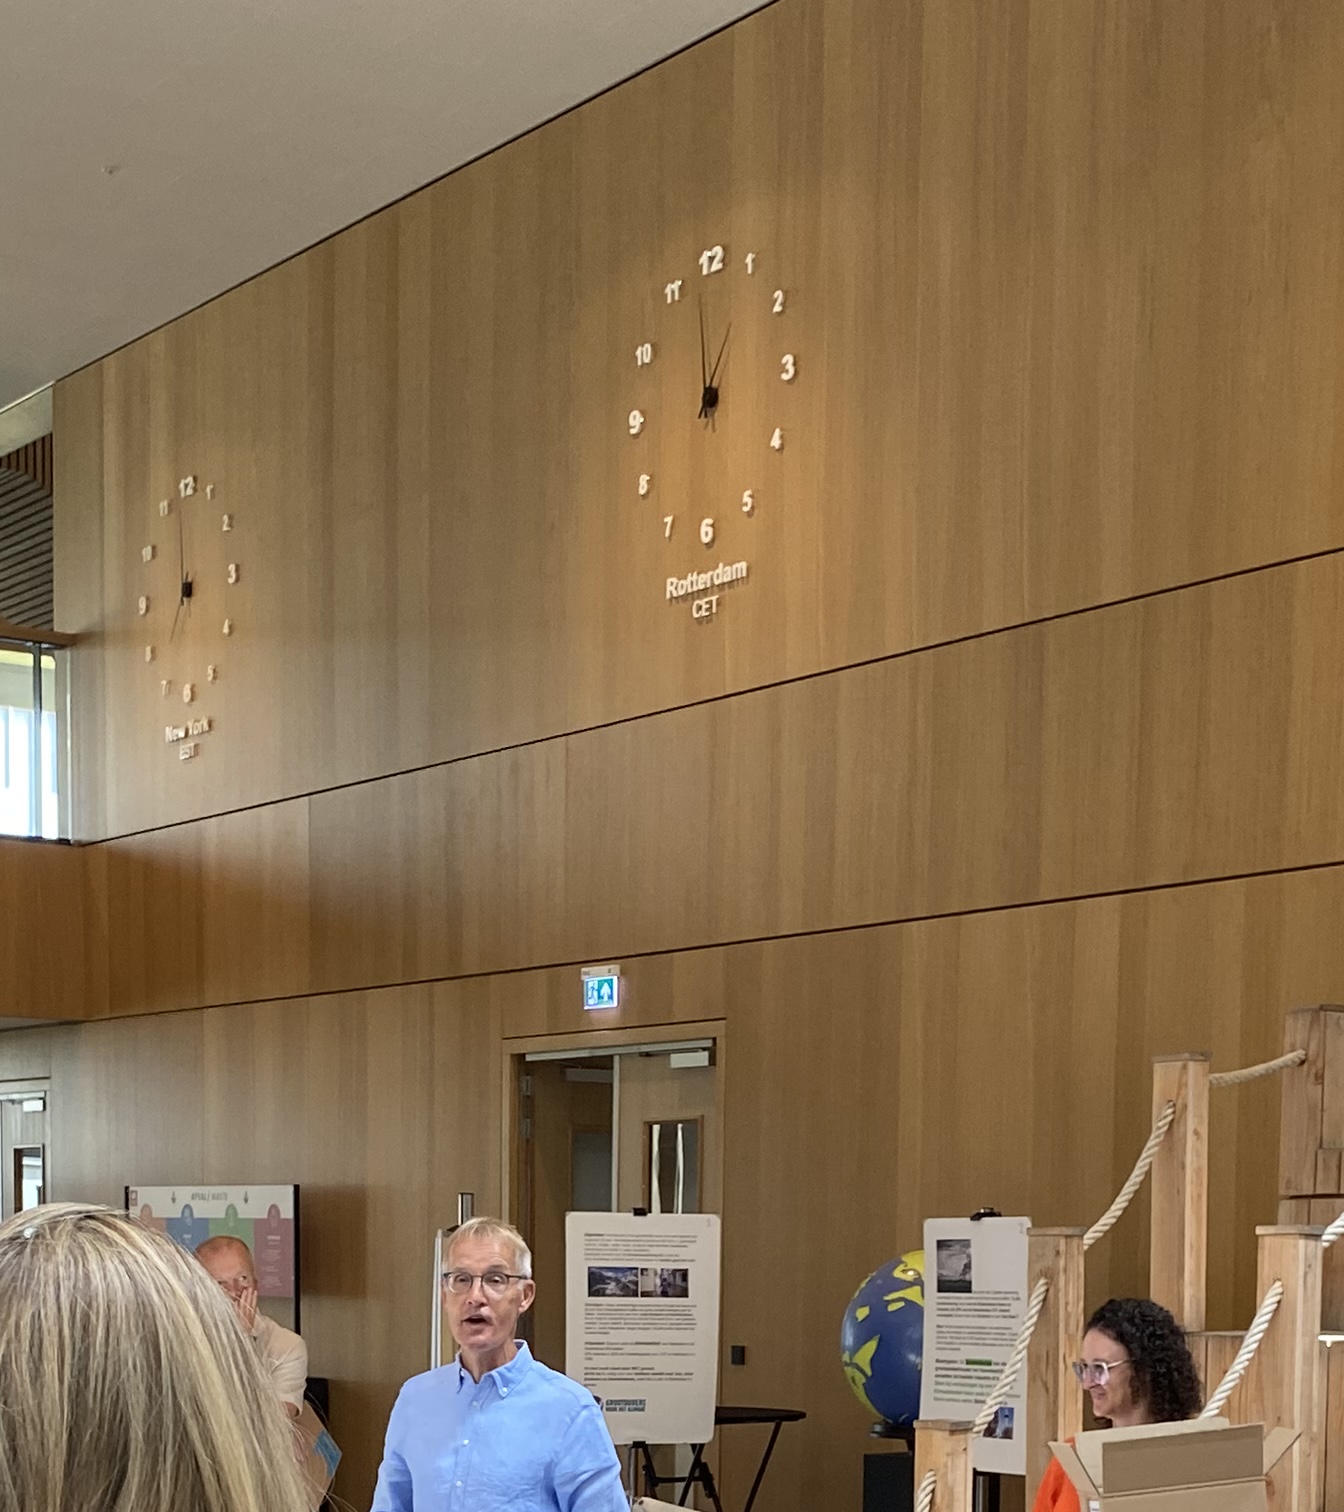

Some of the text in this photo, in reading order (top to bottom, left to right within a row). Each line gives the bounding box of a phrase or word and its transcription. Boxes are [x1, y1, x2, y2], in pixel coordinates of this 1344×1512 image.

[698, 246, 725, 275] 12
[744, 253, 755, 274] 1
[664, 280, 682, 303] 11
[772, 289, 784, 313] 2
[635, 343, 652, 366] 10
[780, 354, 796, 381] 3
[628, 409, 644, 435] 9
[770, 428, 782, 449] 4
[179, 475, 195, 498] 12
[638, 474, 650, 495] 8
[742, 490, 753, 512] 5
[222, 515, 231, 531] 2
[663, 516, 673, 538] 7
[699, 518, 714, 544] 6
[227, 563, 236, 584] 3
[666, 560, 747, 600] Rotterdam
[138, 596, 147, 615] 9
[691, 595, 719, 619] CET
[223, 618, 230, 635] 4
[207, 664, 214, 682] 5
